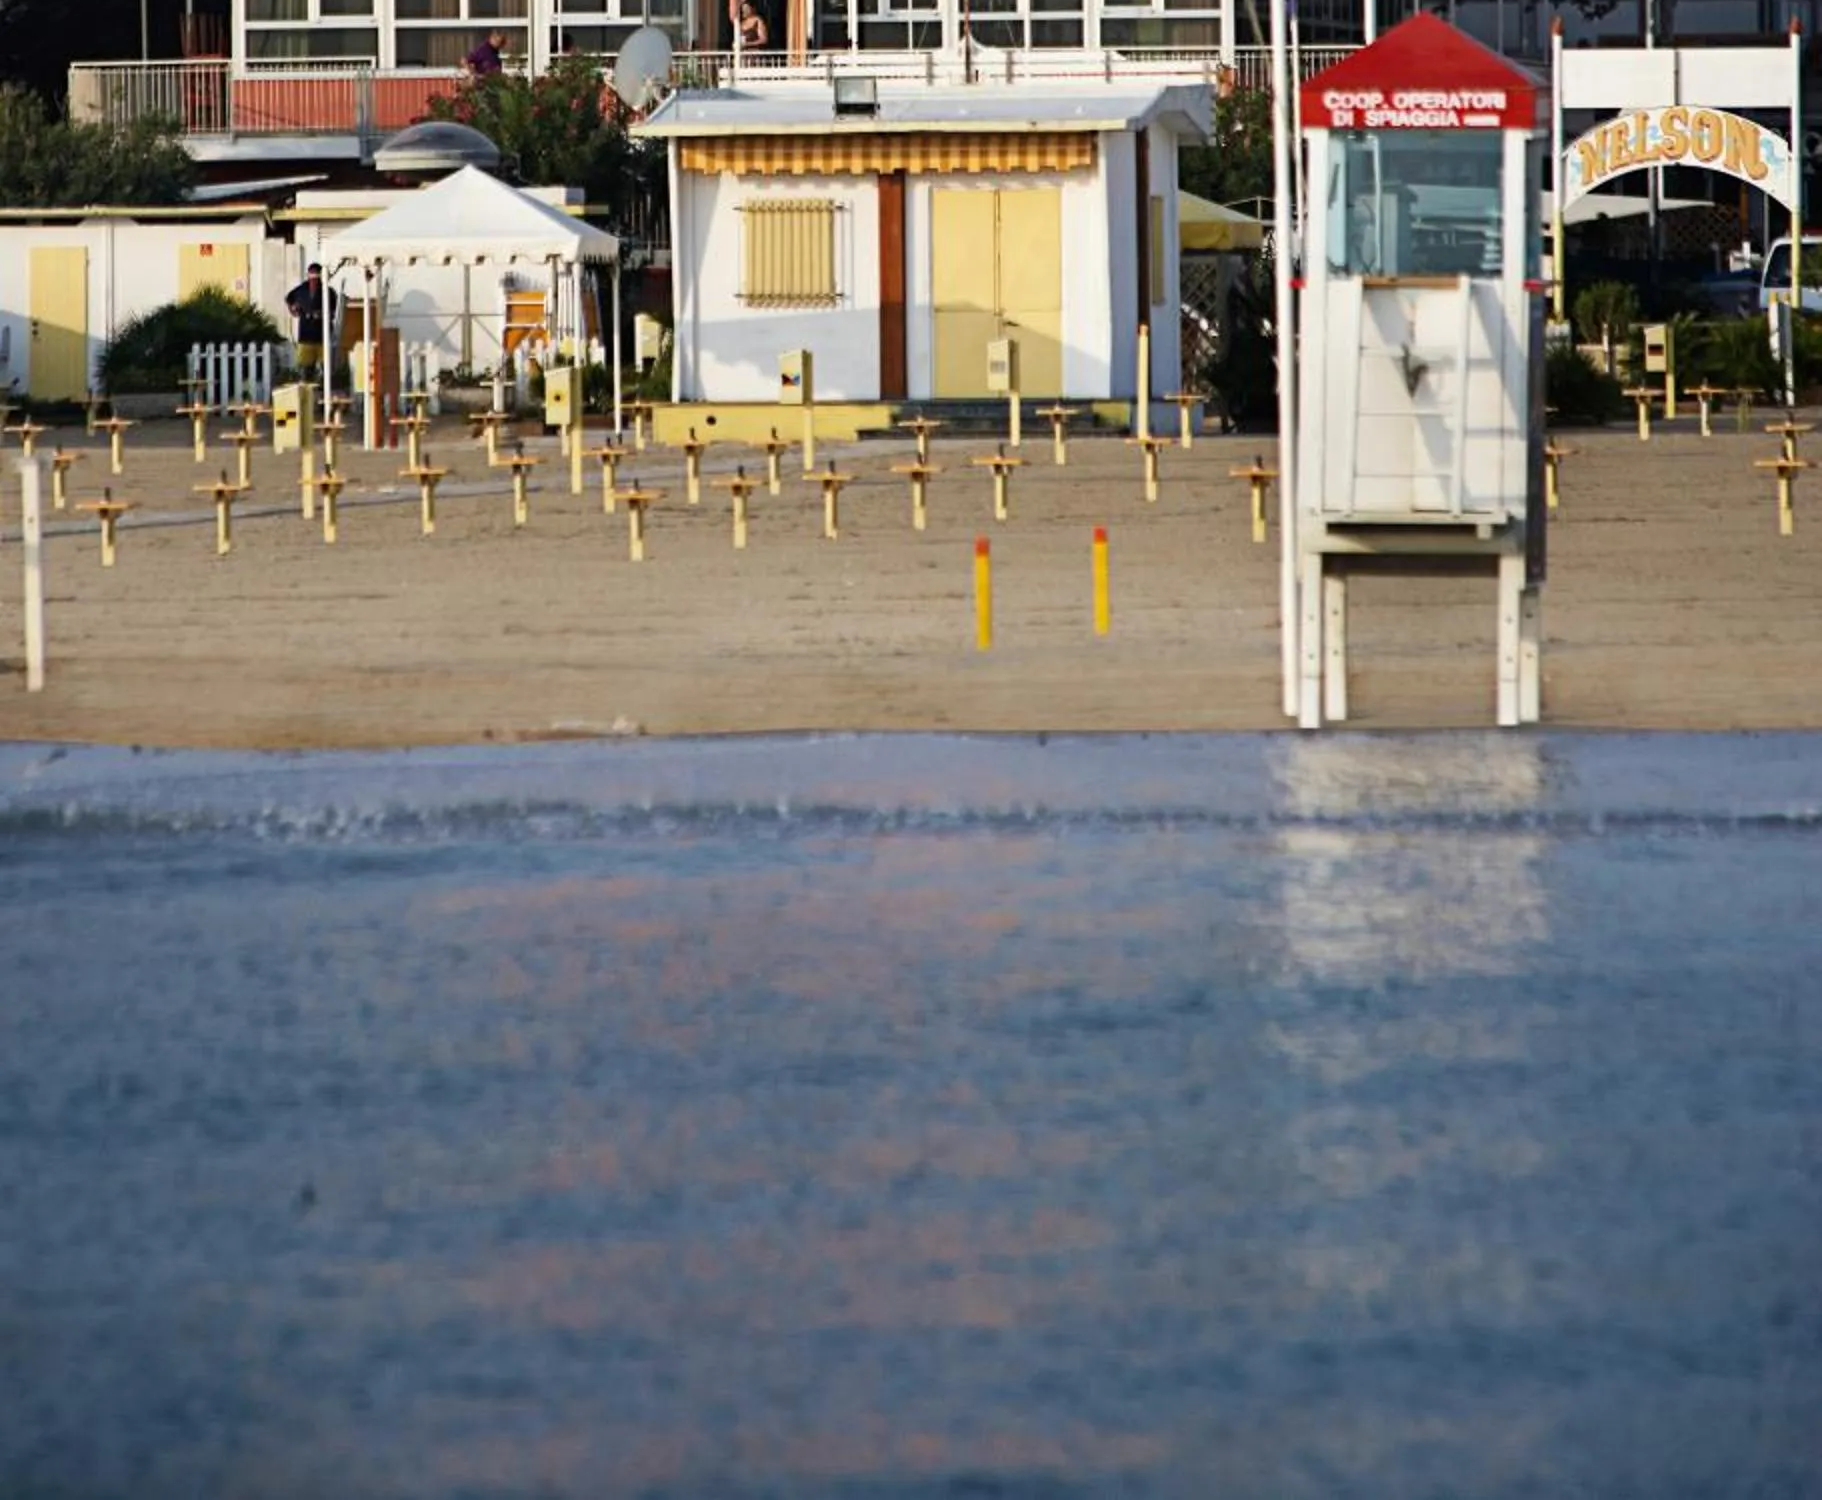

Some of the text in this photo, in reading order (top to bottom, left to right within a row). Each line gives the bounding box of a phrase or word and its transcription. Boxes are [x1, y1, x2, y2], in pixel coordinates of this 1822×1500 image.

[1323, 91, 1506, 109] COOP. OPERATORI
[1332, 110, 1460, 126] DI SPIAGGIA
[1577, 106, 1768, 185] NELSON
